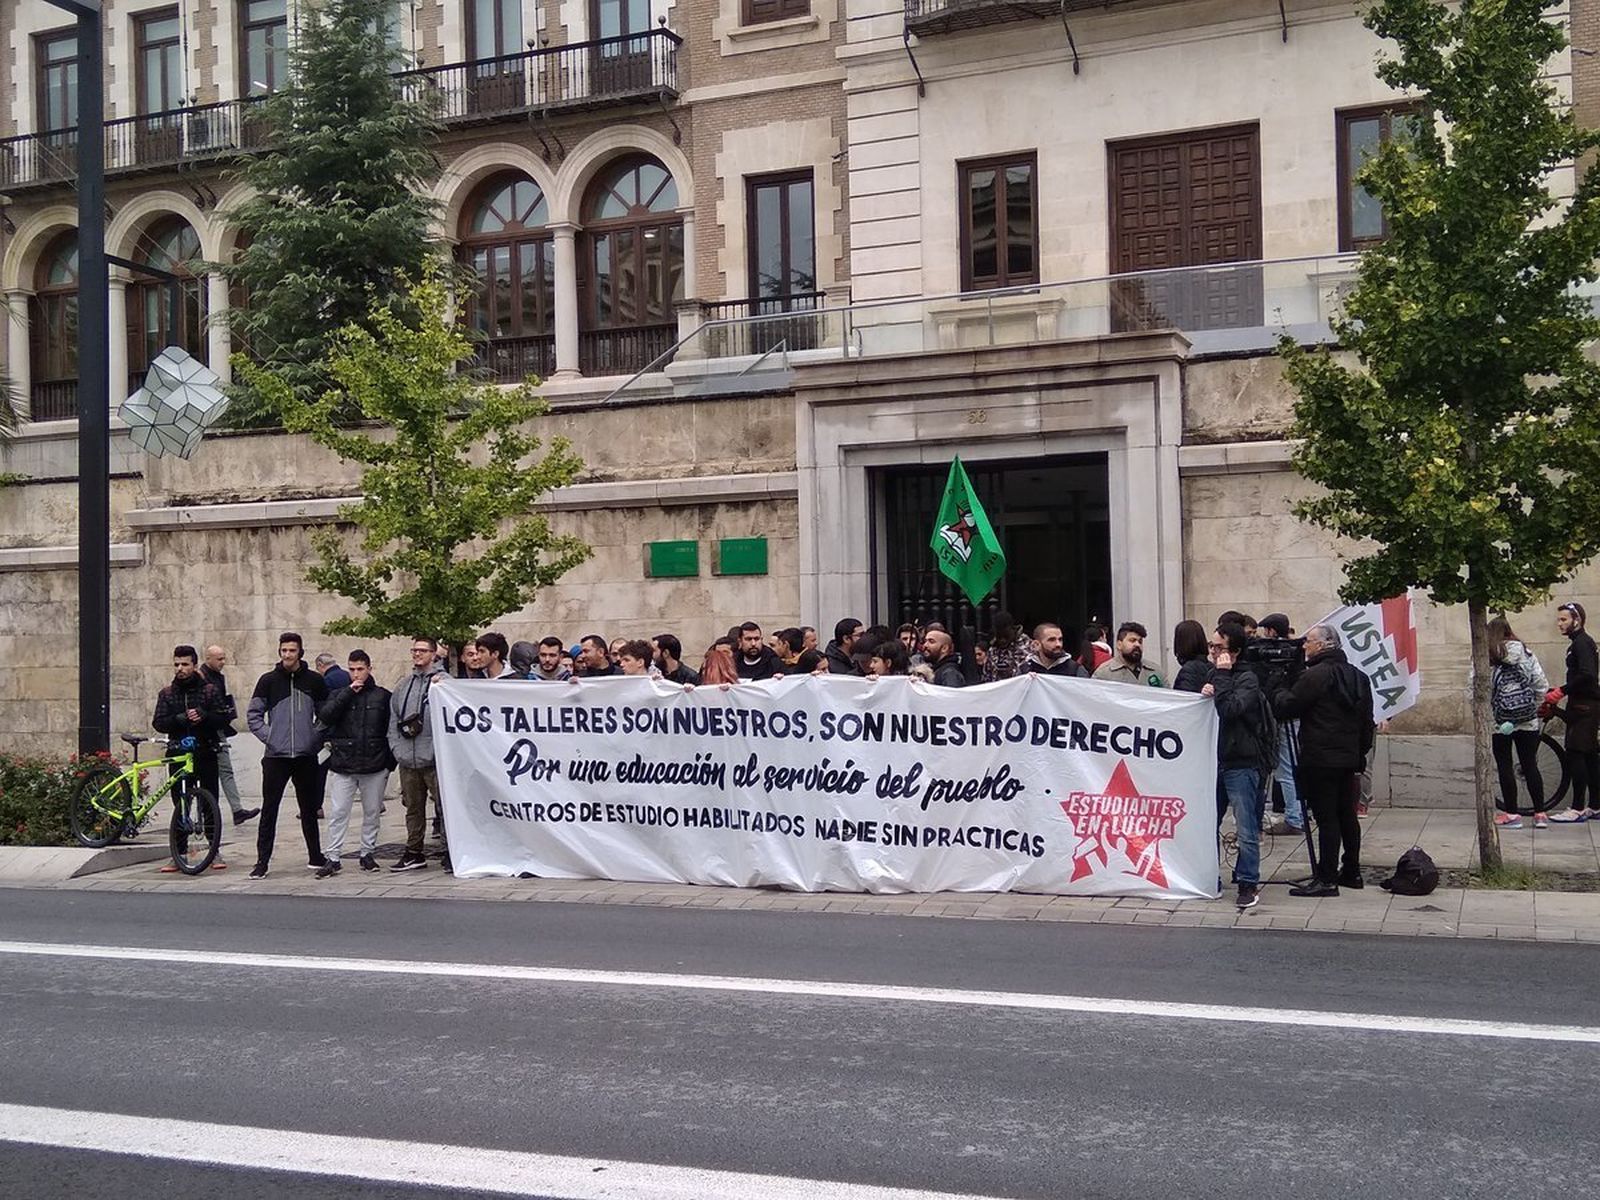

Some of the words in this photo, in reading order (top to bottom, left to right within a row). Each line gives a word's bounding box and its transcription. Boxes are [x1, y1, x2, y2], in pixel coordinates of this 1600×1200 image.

[1341, 610, 1407, 710] USTEA
[442, 706, 492, 733] LOS
[500, 706, 618, 733] TALLERES
[622, 706, 668, 734] SON
[673, 706, 814, 742] NUESTROS,
[820, 711, 885, 742] SON
[891, 714, 1027, 746] NUESTRO
[1030, 716, 1183, 760] DERECHO
[503, 738, 561, 786] Por
[568, 758, 611, 784] una
[615, 753, 726, 791] educación
[733, 752, 760, 788] al
[763, 757, 869, 793] servicio
[875, 762, 923, 799] del
[920, 764, 1025, 811] pueblo
[490, 800, 576, 822] CENTROS
[579, 802, 603, 822] DE
[606, 804, 679, 827] ESTUDIO
[683, 808, 805, 837] HABILITADOS
[815, 818, 877, 843] NADIE
[881, 822, 918, 847] SIN
[922, 826, 1045, 858] PRACTICAS
[1068, 794, 1182, 818] ESTUDIANTES
[1075, 815, 1102, 835] EN
[1111, 816, 1172, 836] LUCHA
